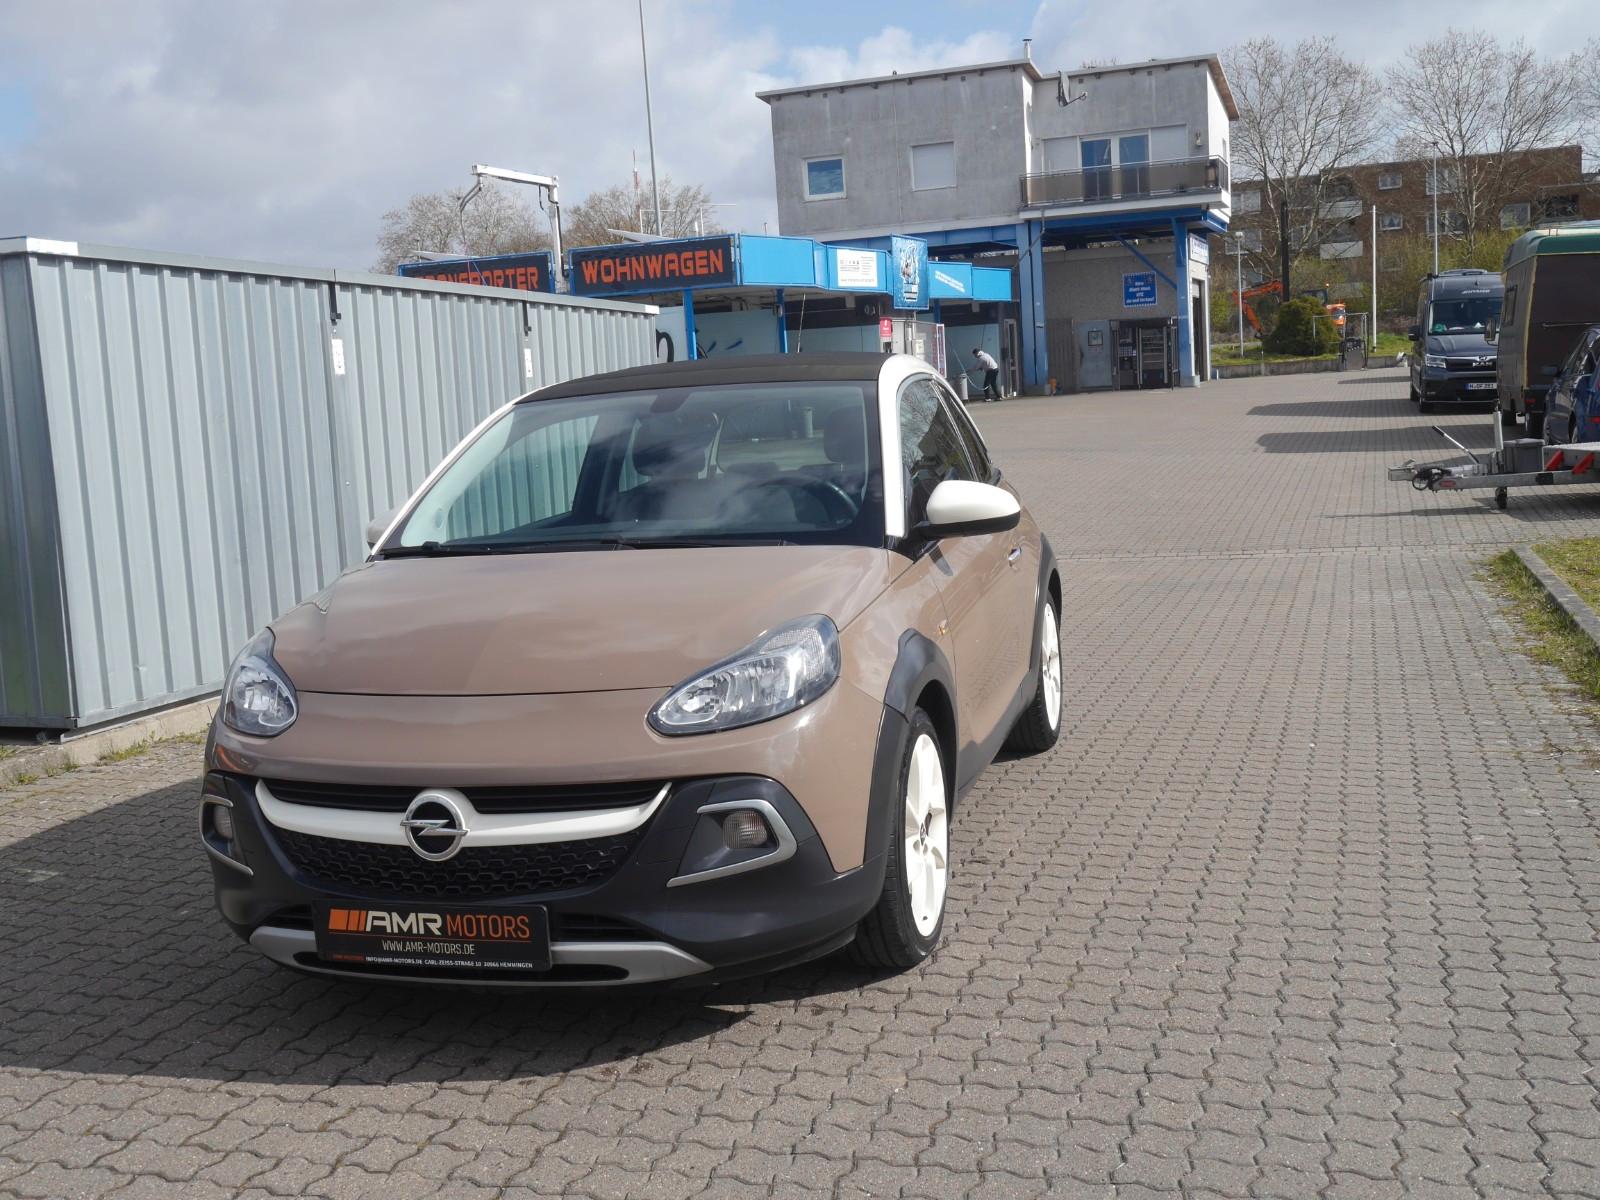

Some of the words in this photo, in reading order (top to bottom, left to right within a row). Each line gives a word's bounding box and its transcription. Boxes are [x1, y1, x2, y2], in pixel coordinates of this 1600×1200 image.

[582, 249, 724, 285] WOHNWAGEN
[366, 910, 443, 935] AMR
[446, 914, 530, 938] MOTORS
[382, 940, 476, 955] WWW.AMR-MOTORS.DE
